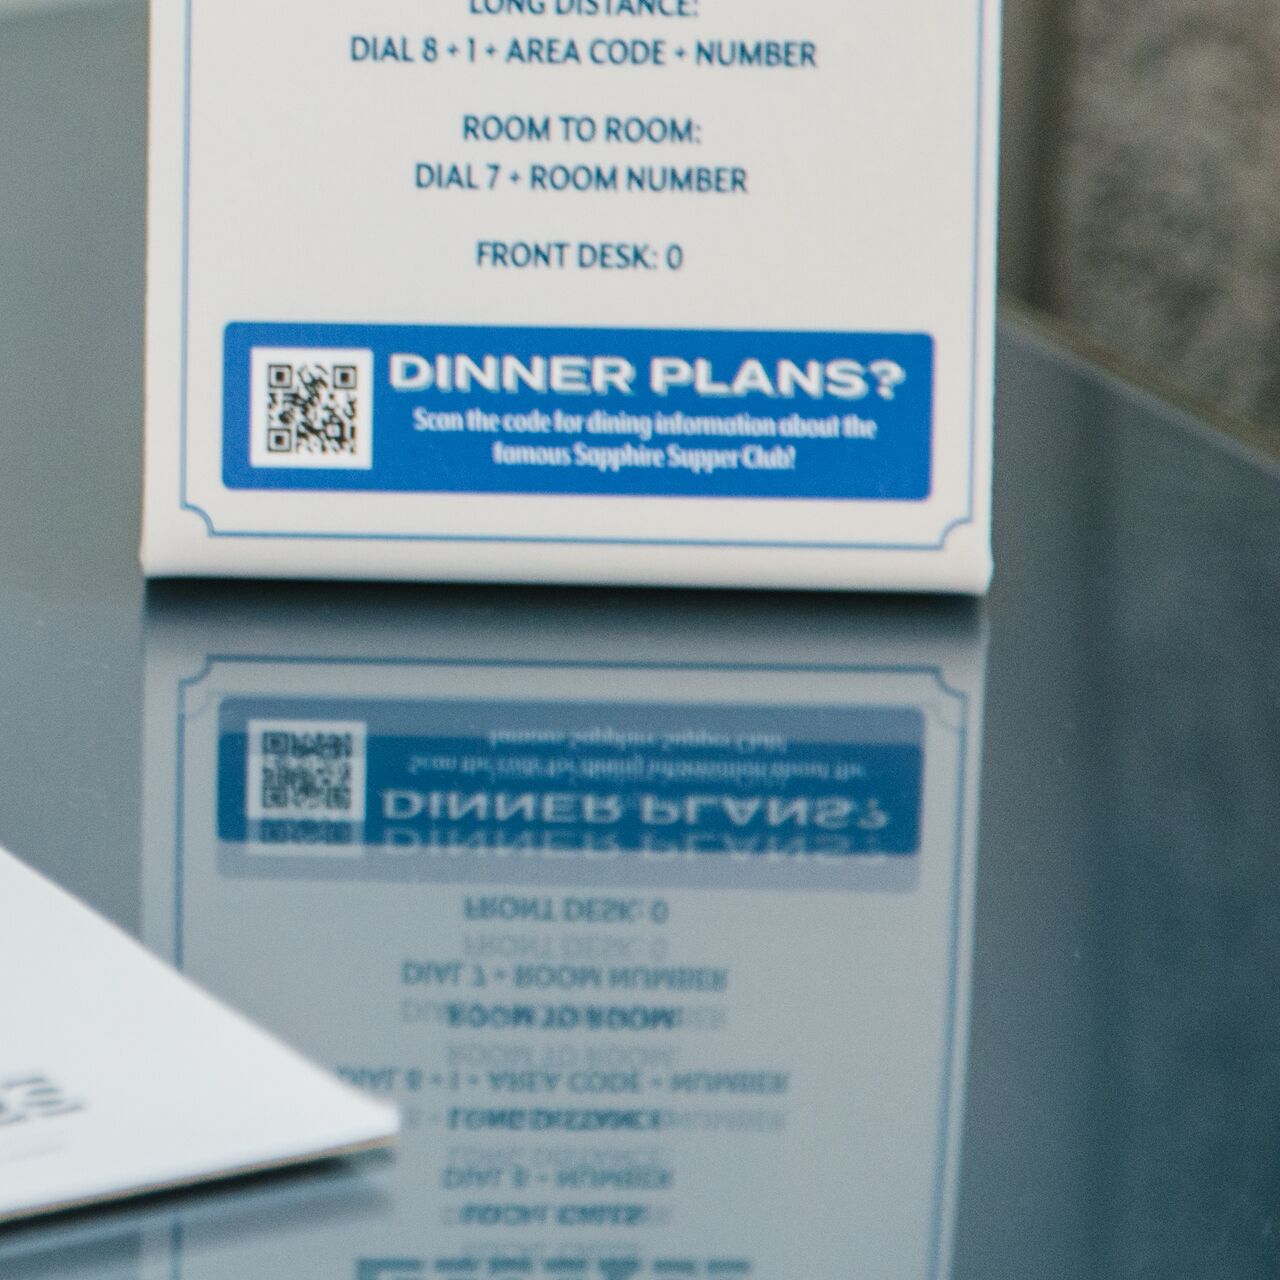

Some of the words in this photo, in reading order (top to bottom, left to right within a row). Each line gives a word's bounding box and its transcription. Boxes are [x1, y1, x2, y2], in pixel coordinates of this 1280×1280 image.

[350, 35, 414, 63] DIAL
[421, 36, 438, 63] 8
[447, 44, 458, 55] +
[467, 37, 476, 63] 1
[485, 45, 496, 56] +
[505, 37, 580, 65] AREA
[588, 38, 664, 66] CODE
[674, 48, 685, 58] +
[695, 40, 816, 68] NUMBER
[462, 114, 550, 142] ROOM
[559, 115, 597, 143] TO
[604, 116, 700, 144] ROOM:
[415, 162, 478, 190] DIAL
[487, 163, 501, 189] 7
[510, 172, 520, 183] +
[529, 164, 618, 191] ROOM
[626, 166, 746, 193] NUMBER
[476, 240, 569, 268] FRONT
[577, 242, 657, 270] DESK:
[665, 243, 683, 271] 0
[388, 352, 636, 394] DINNER
[649, 356, 906, 400] PLANS?
[413, 406, 464, 433] Scan
[465, 407, 500, 433] the
[502, 408, 551, 433] code
[553, 408, 584, 433] for
[586, 409, 653, 441] dining
[655, 410, 777, 437] information
[778, 413, 840, 438] about
[842, 414, 878, 440] the
[492, 440, 572, 466] famous
[572, 441, 665, 473] Sapphire
[666, 443, 740, 474] Supper
[741, 444, 797, 470] Club!
